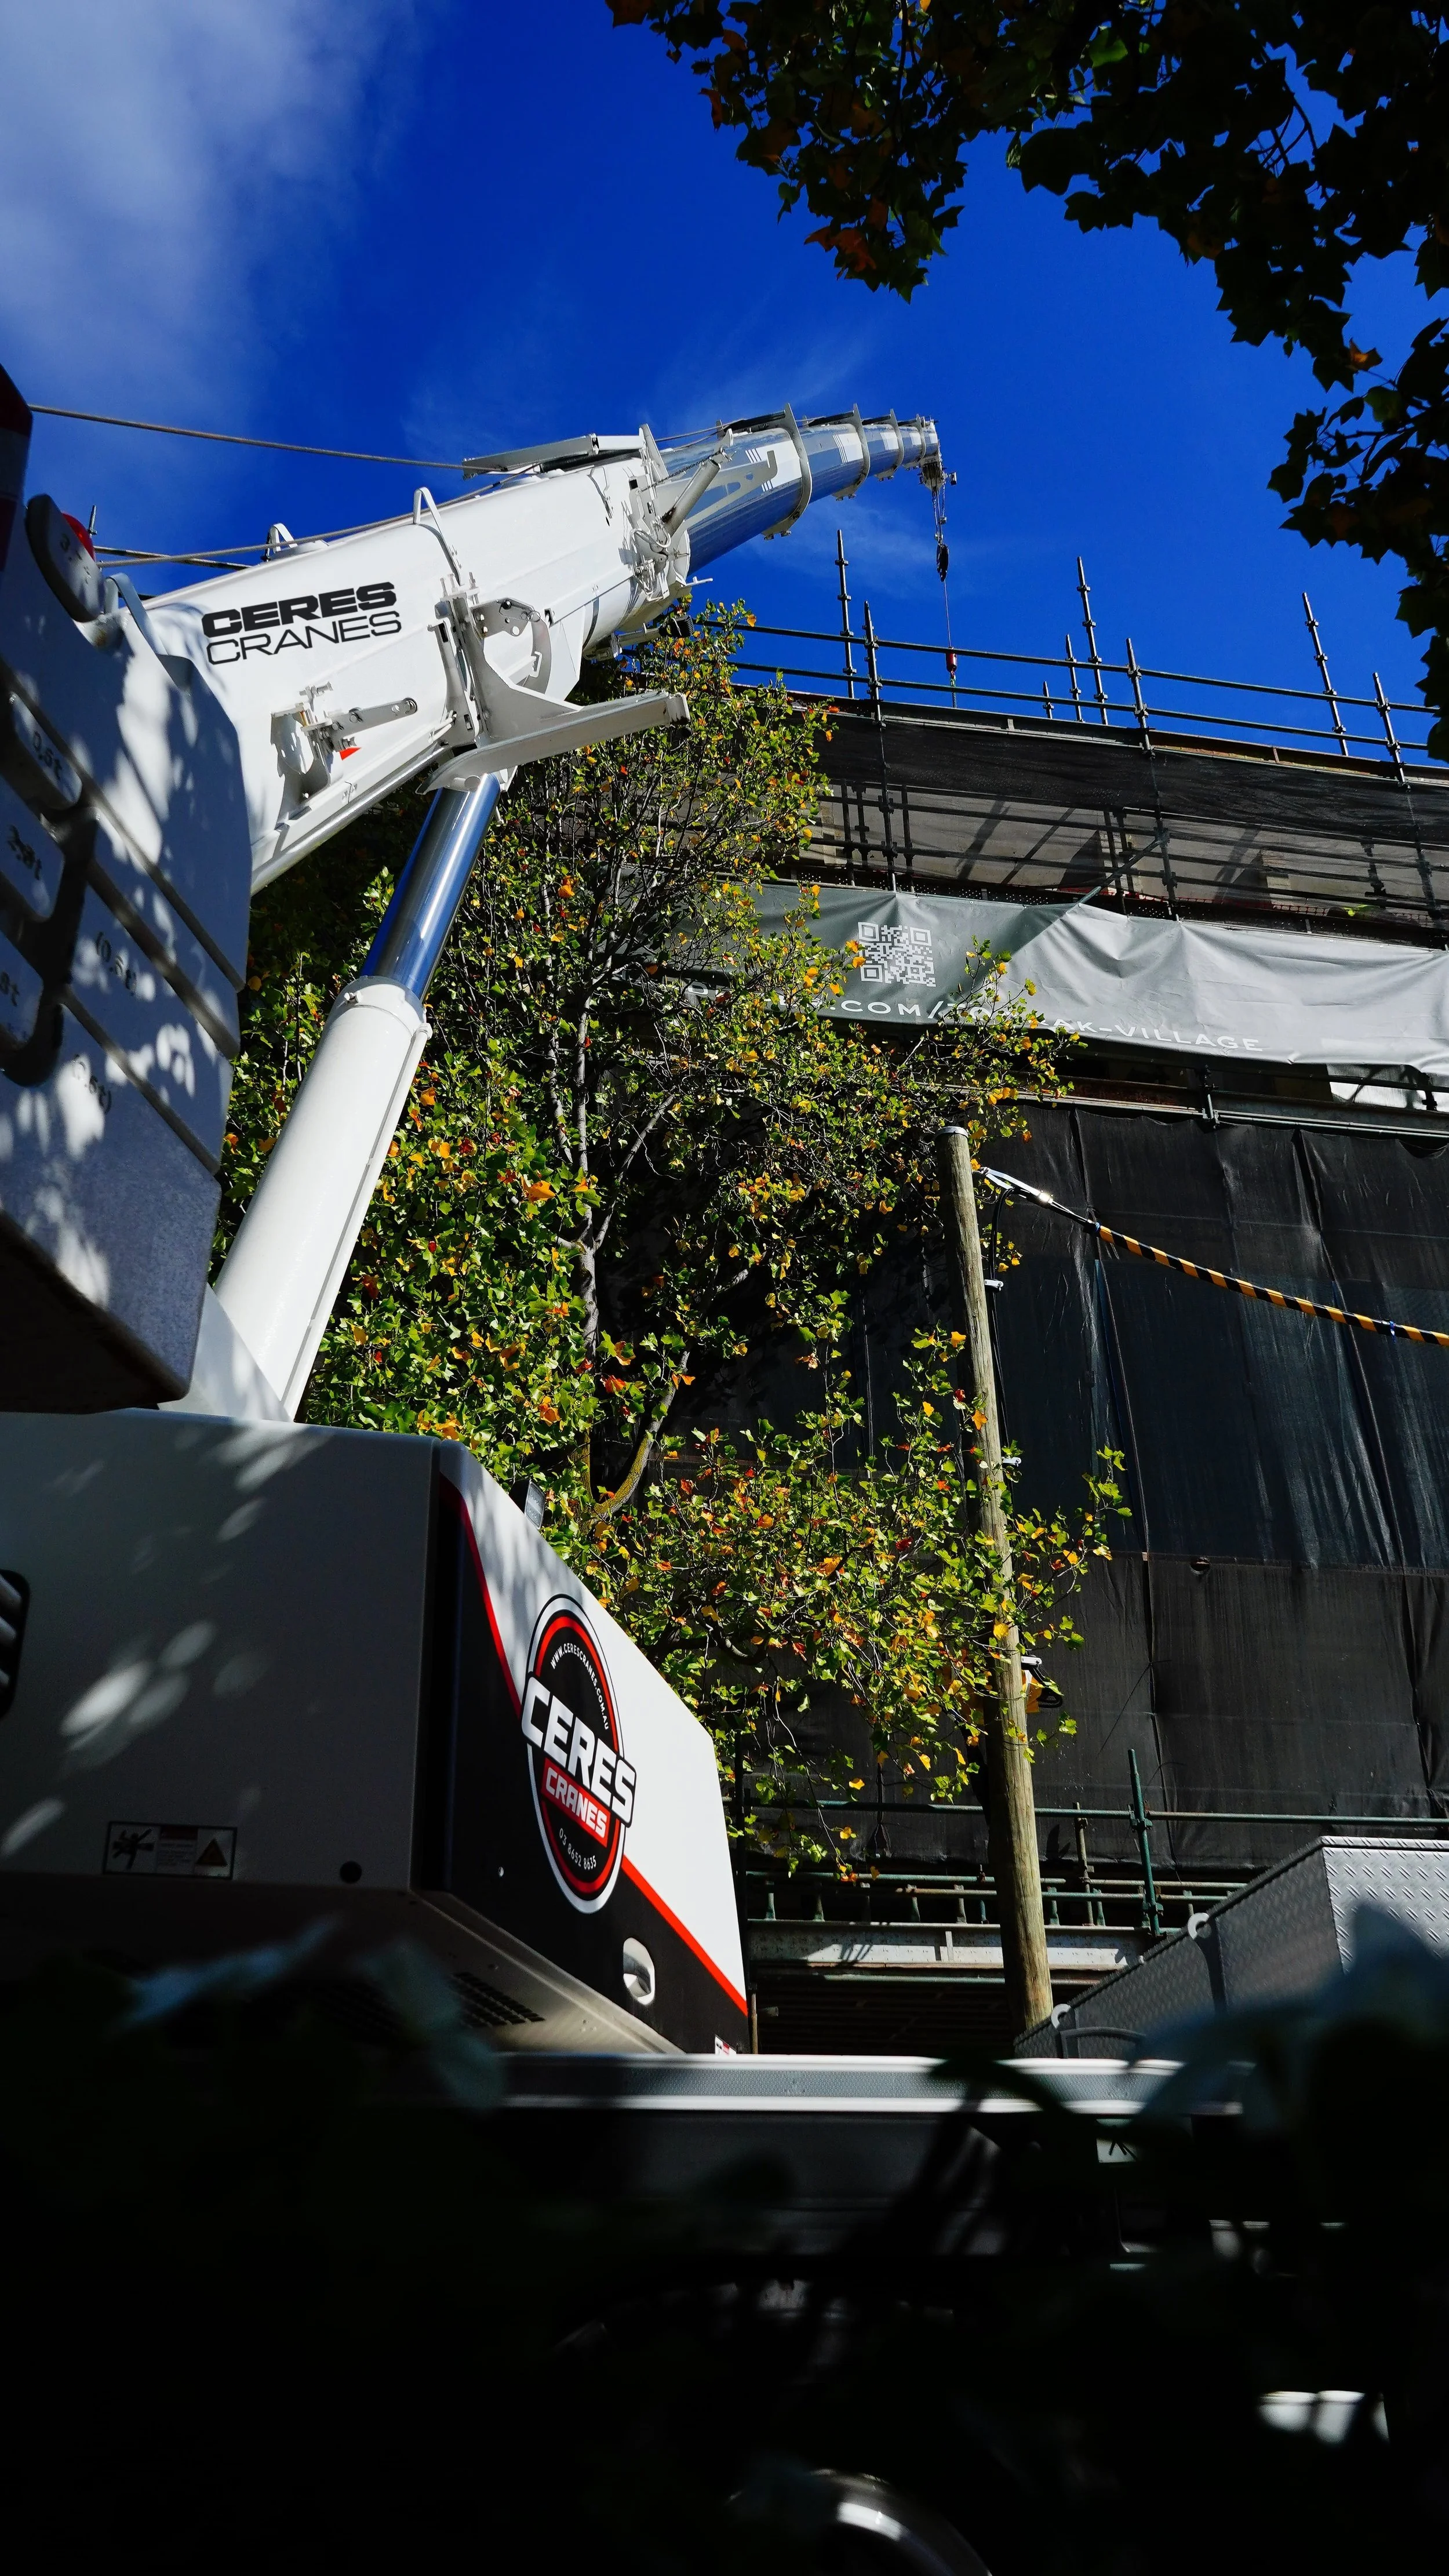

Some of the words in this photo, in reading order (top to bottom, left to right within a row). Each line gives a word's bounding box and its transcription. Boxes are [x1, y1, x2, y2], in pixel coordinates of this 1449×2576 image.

[201, 582, 397, 638] CERES
[206, 610, 402, 665] CRANES
[551, 1643, 609, 1730] WWW.CERESCRANES.COM.AU
[522, 1676, 635, 1824] CERES
[546, 1766, 606, 1839] CRANES
[559, 1827, 567, 1846] 03
[567, 1843, 581, 1867] 8652
[583, 1855, 596, 1870] 8635
